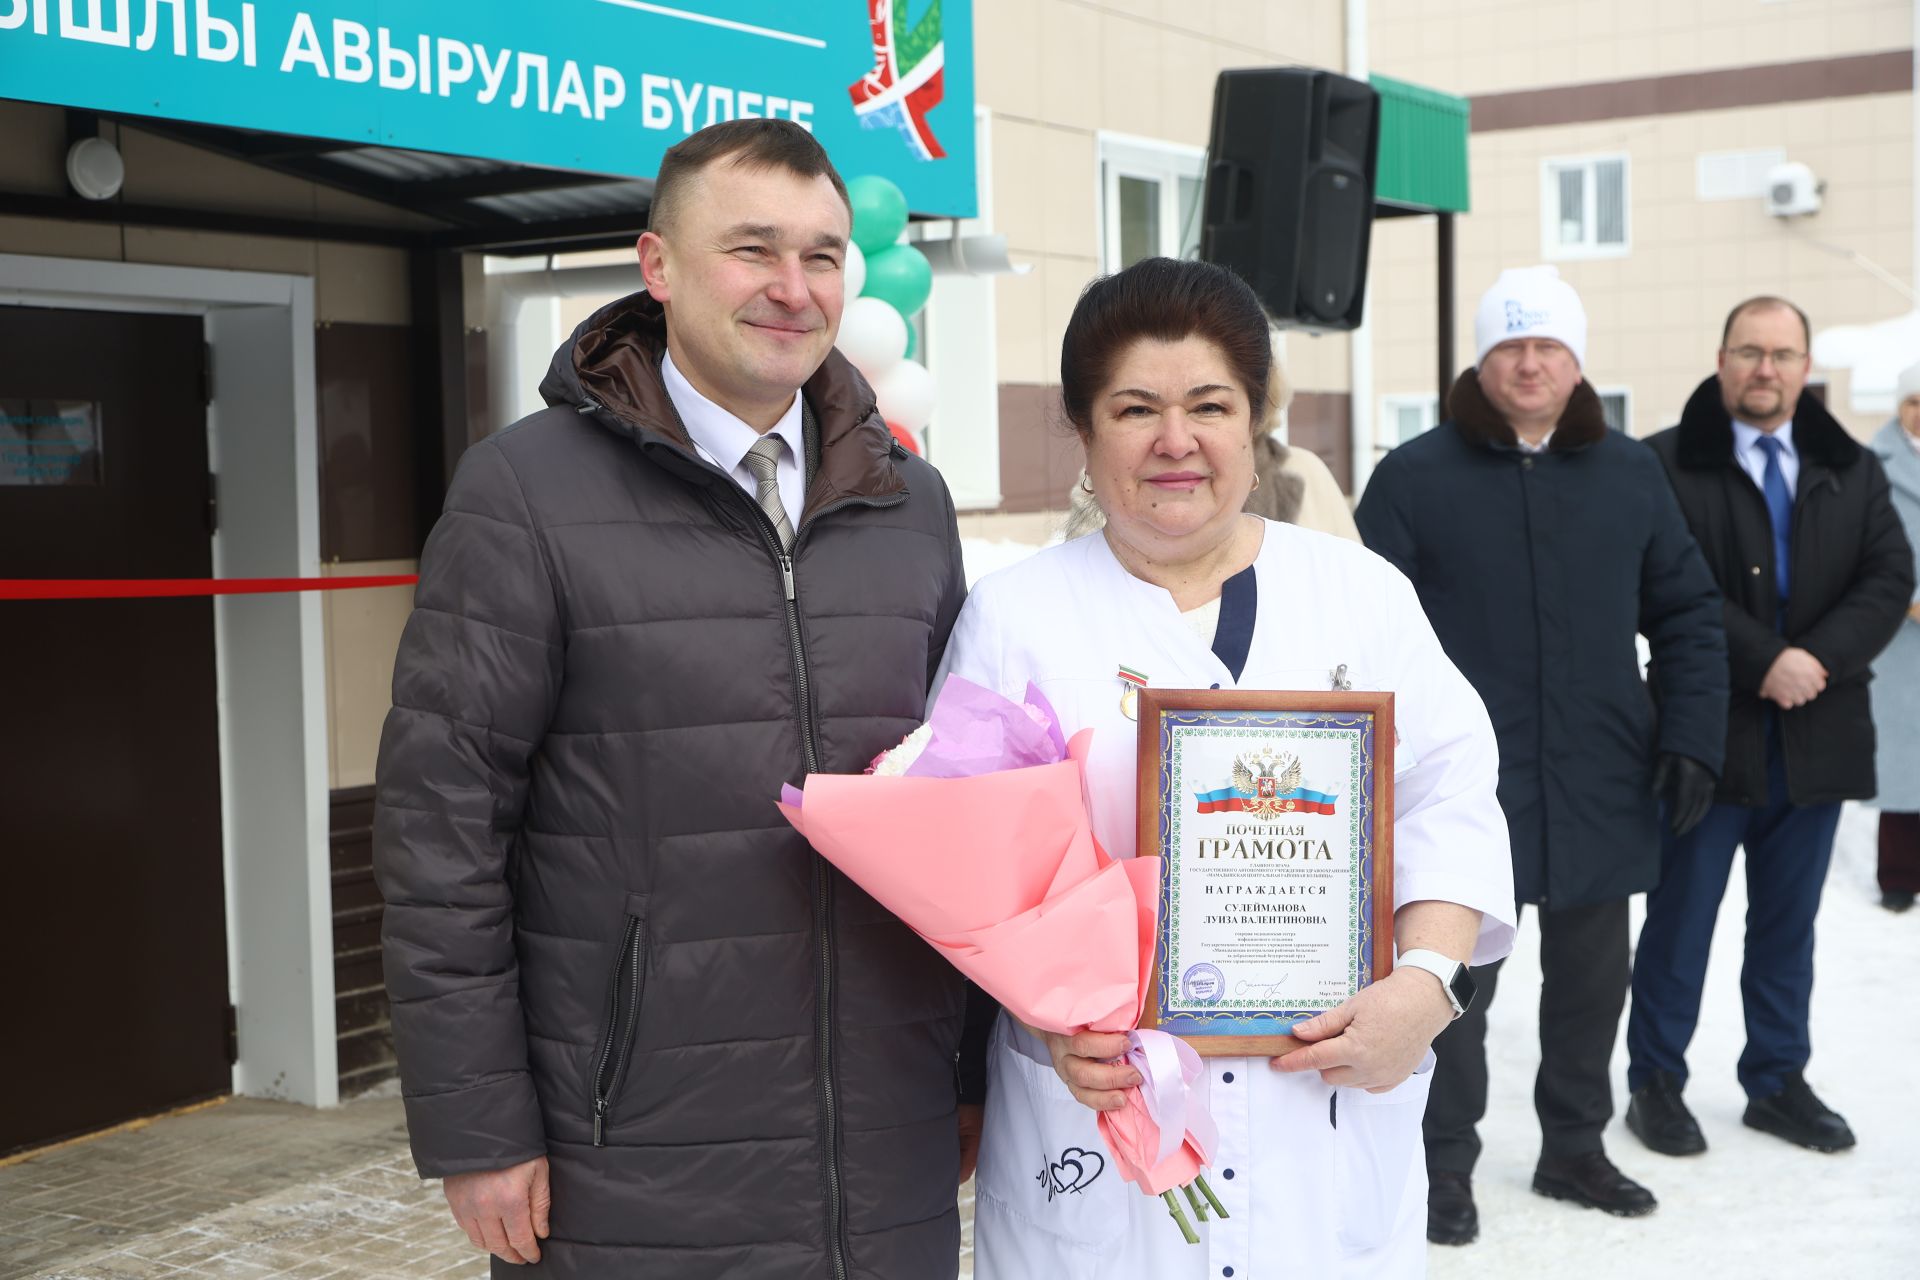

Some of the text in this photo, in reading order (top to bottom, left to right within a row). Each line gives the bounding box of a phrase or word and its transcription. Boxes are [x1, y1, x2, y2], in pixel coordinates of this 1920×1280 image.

[280, 11, 626, 121] АВЫРУЛАР
[1226, 823, 1305, 836] ПОЧЕТНАЯ
[1197, 837, 1333, 861] ГРАМОТА
[1205, 885, 1327, 895] НАГРАЖДАЕТСЯ
[1224, 902, 1306, 913] СУЛЕЙМАНОВА
[1203, 915, 1327, 925] ЛУИЗА ВАЛЕНТИНОВНА
